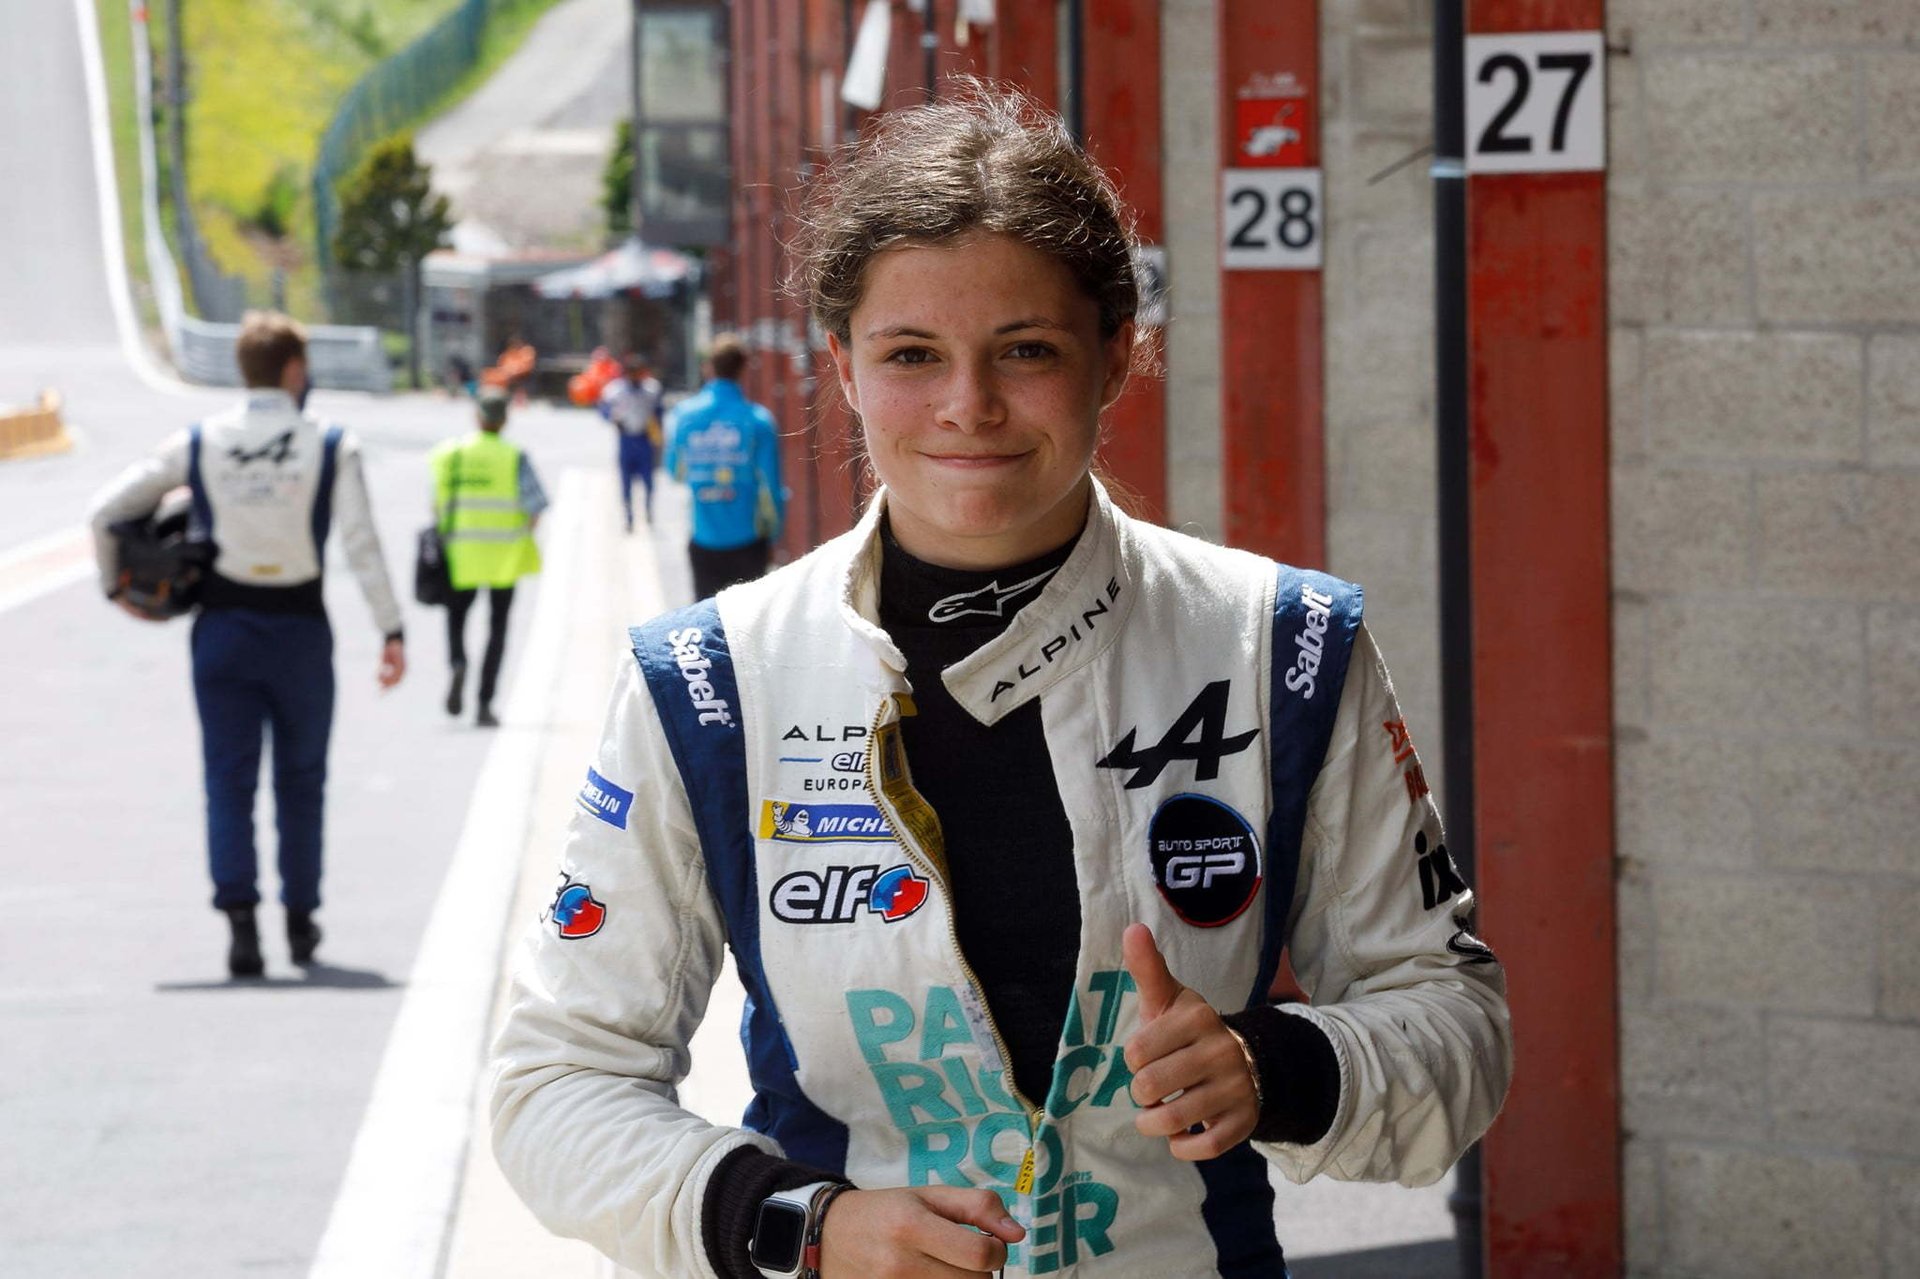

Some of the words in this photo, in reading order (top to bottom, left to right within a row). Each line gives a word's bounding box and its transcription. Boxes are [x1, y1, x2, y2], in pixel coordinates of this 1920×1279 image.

[1477, 53, 1593, 153] 27
[1229, 187, 1315, 250] 28
[668, 627, 731, 727] Sabelt
[990, 576, 1121, 703] ALPINE
[1285, 584, 1333, 699] Sabelt
[770, 864, 879, 923] elf
[1165, 851, 1246, 890] GP
